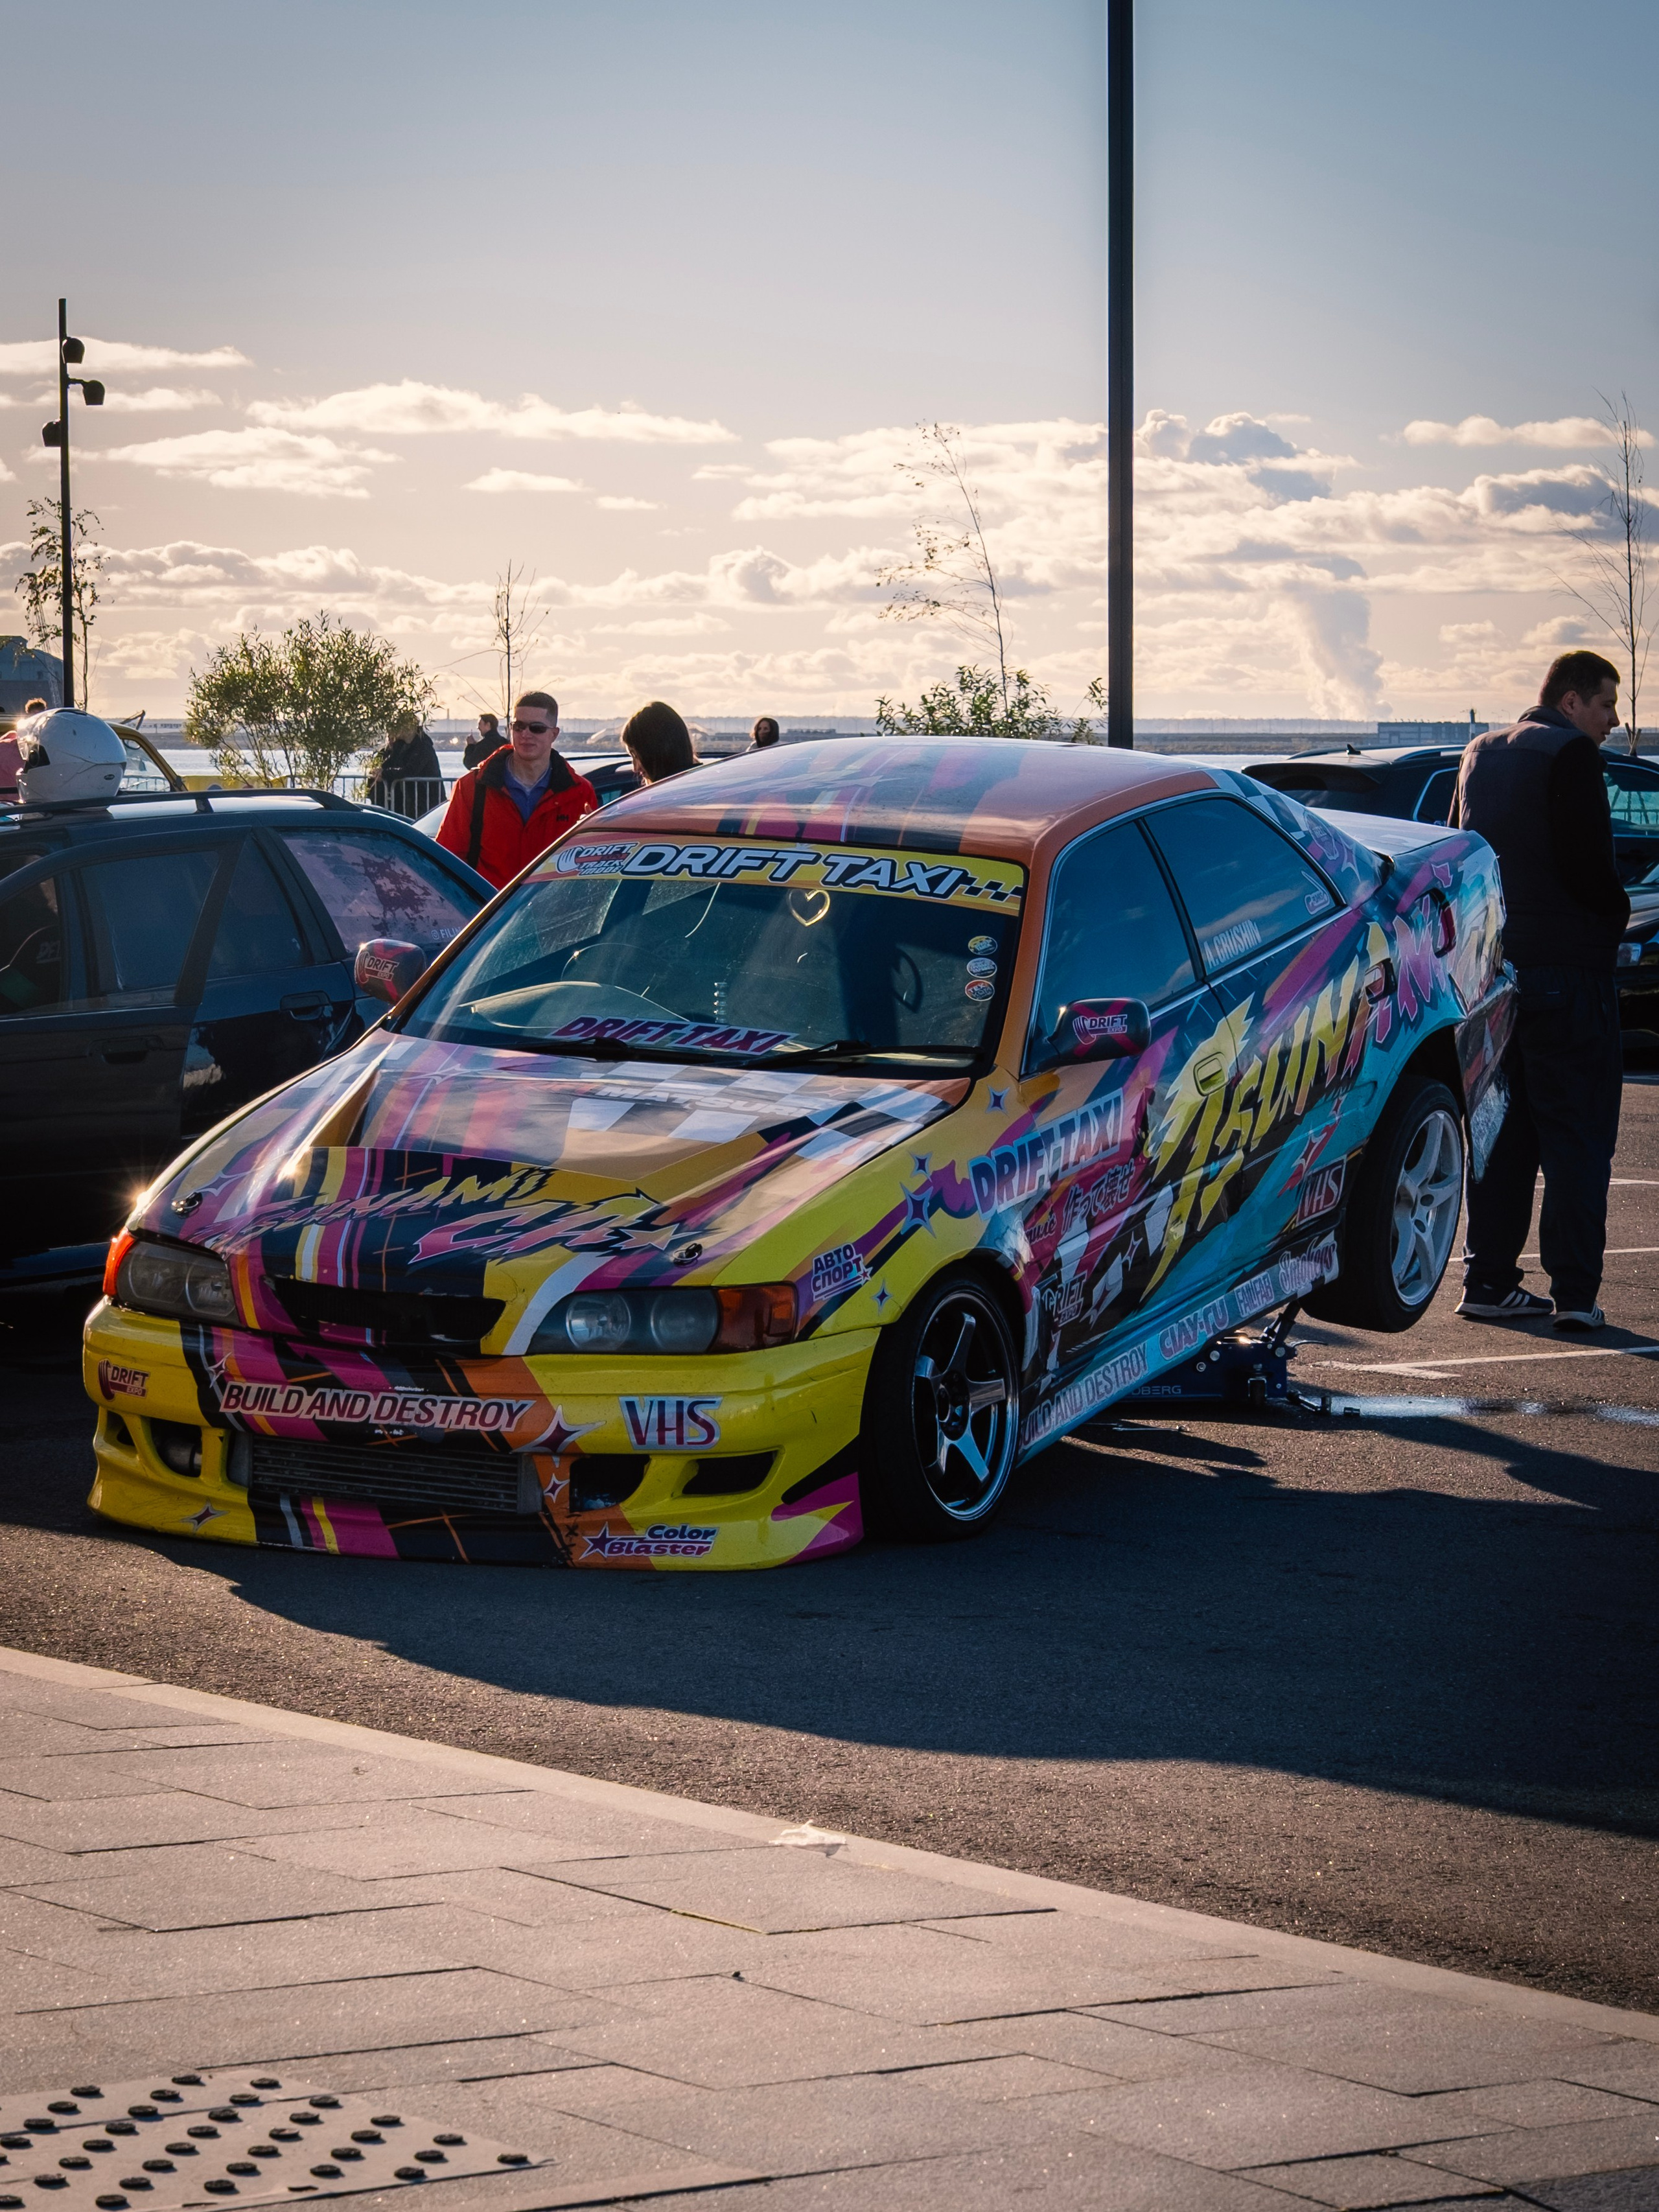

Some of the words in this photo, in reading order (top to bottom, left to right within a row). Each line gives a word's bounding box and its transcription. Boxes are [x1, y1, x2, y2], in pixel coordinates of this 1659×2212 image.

[578, 843, 636, 857] DRIFT
[623, 845, 816, 879] DRIFT
[826, 855, 964, 896] TAXI
[367, 957, 399, 973] DRIFT
[556, 1017, 684, 1043] DRIFT
[678, 1026, 791, 1053] TAXI
[1089, 1015, 1126, 1029] DRIFT
[971, 1127, 1055, 1215] DRIFT
[1058, 1094, 1122, 1174] TAXI
[1302, 1165, 1343, 1217] VHS
[812, 1257, 862, 1292] СПОРТ
[814, 1244, 854, 1275] АВТО
[110, 1366, 149, 1387] DRIFT
[126, 1386, 143, 1395] EXPO
[1055, 1383, 1084, 1428] AND
[1083, 1344, 1149, 1407] DESTROY
[224, 1386, 300, 1415] BUILD
[305, 1389, 369, 1419] AND
[373, 1396, 529, 1428] DESTROY
[624, 1399, 718, 1446] VHS
[607, 1540, 712, 1556] Blaster
[647, 1524, 717, 1540] Color
